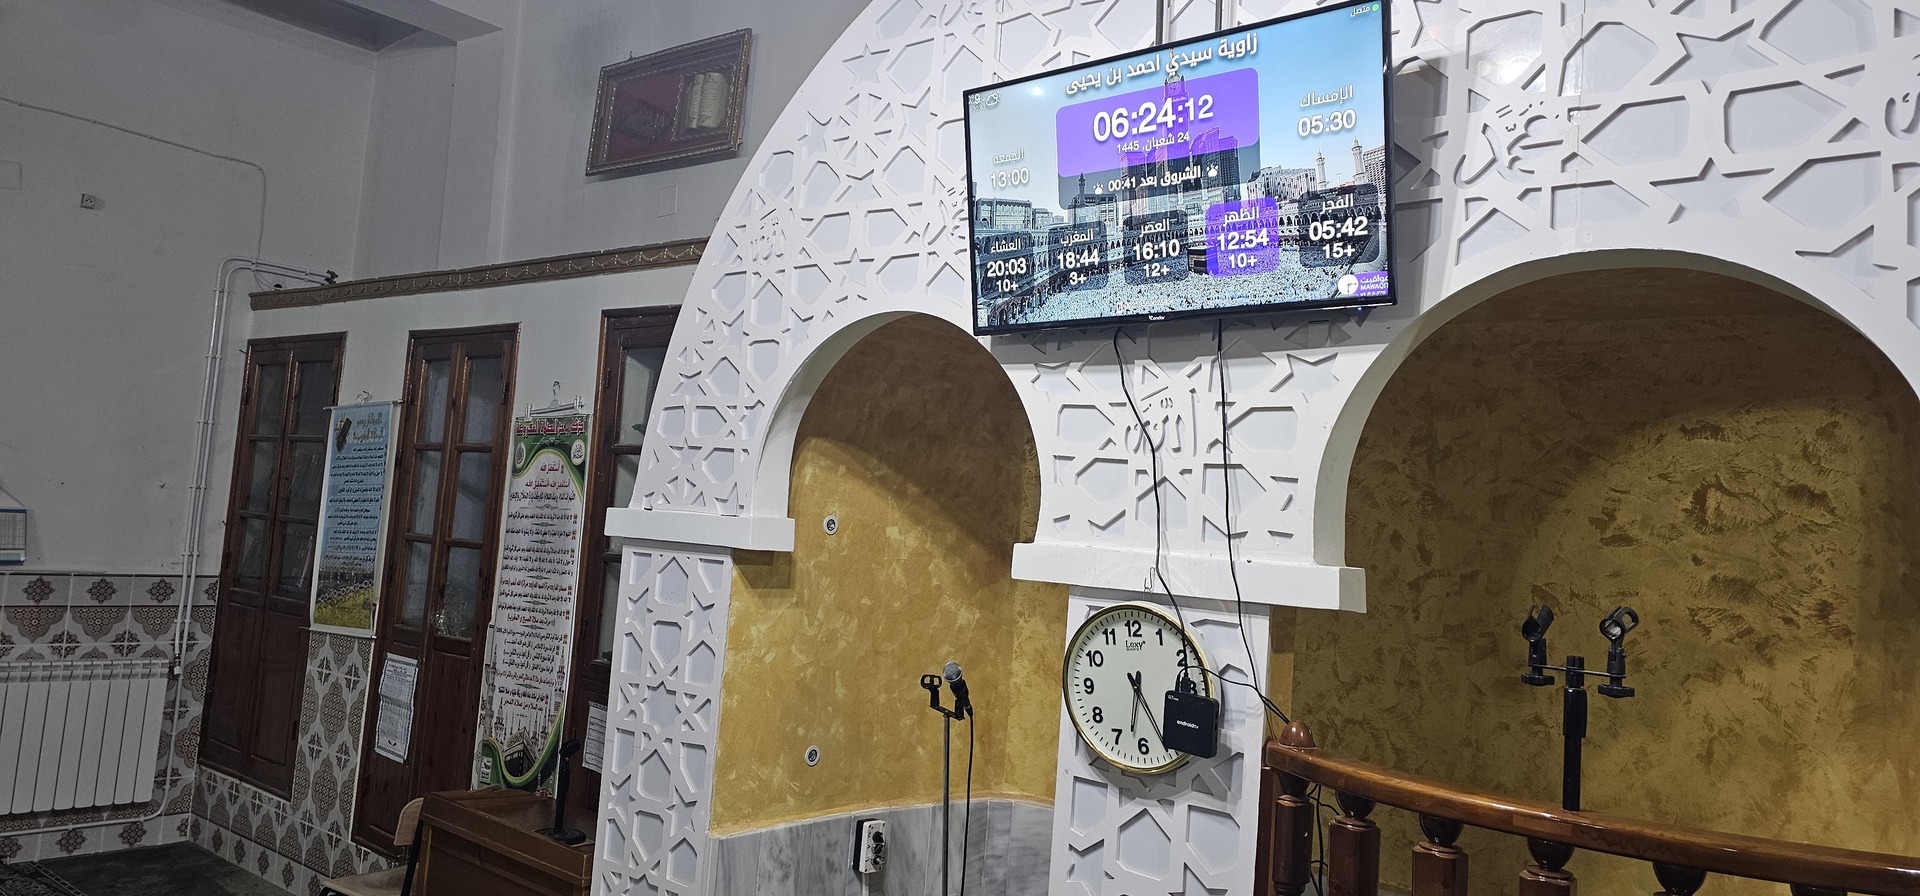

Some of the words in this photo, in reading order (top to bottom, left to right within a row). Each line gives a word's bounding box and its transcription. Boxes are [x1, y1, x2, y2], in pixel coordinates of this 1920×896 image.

[1350, 6, 1371, 17] متصل
[1218, 32, 1258, 59] زاوية
[1126, 54, 1160, 79] احمد
[1165, 47, 1213, 76] سيدي
[1106, 66, 1122, 86] بن
[1299, 84, 1354, 108] الإمساك
[1093, 94, 1214, 142] 06:24:12
[1298, 109, 1356, 137] 05:30
[1177, 132, 1190, 143] 24
[992, 148, 1024, 164] الجمعة
[1116, 141, 1140, 154] 1445
[990, 167, 1030, 189] 13:00
[1140, 176, 1158, 188] بعد
[1161, 165, 1202, 187] الشروق
[1108, 180, 1136, 192] 00:41
[1321, 194, 1354, 215] الفجر
[1223, 206, 1260, 227] الظهر
[1139, 218, 1170, 238] العصر
[1308, 216, 1368, 241] 05:42
[990, 238, 1022, 254] العشاء
[1060, 228, 1094, 247] المغرب
[1217, 228, 1269, 251] 12:54
[1057, 248, 1100, 270] 18:44
[1133, 239, 1180, 261] 16:10
[1322, 242, 1356, 259] 15+
[986, 258, 1027, 278] 20:03
[1143, 262, 1171, 278] 12+
[1228, 253, 1258, 269] 10+
[996, 279, 1019, 292] 10+
[1069, 272, 1087, 286] 3+
[1102, 628, 1116, 646] 11
[1124, 620, 1142, 638] 12
[1156, 628, 1164, 646] 1
[1126, 640, 1144, 650] Lexy
[1086, 650, 1104, 668] 10
[1176, 649, 1186, 667] 2
[1084, 678, 1094, 694] 9
[1092, 706, 1104, 724] 8
[1111, 728, 1123, 745] 7
[1138, 738, 1150, 755] 6
